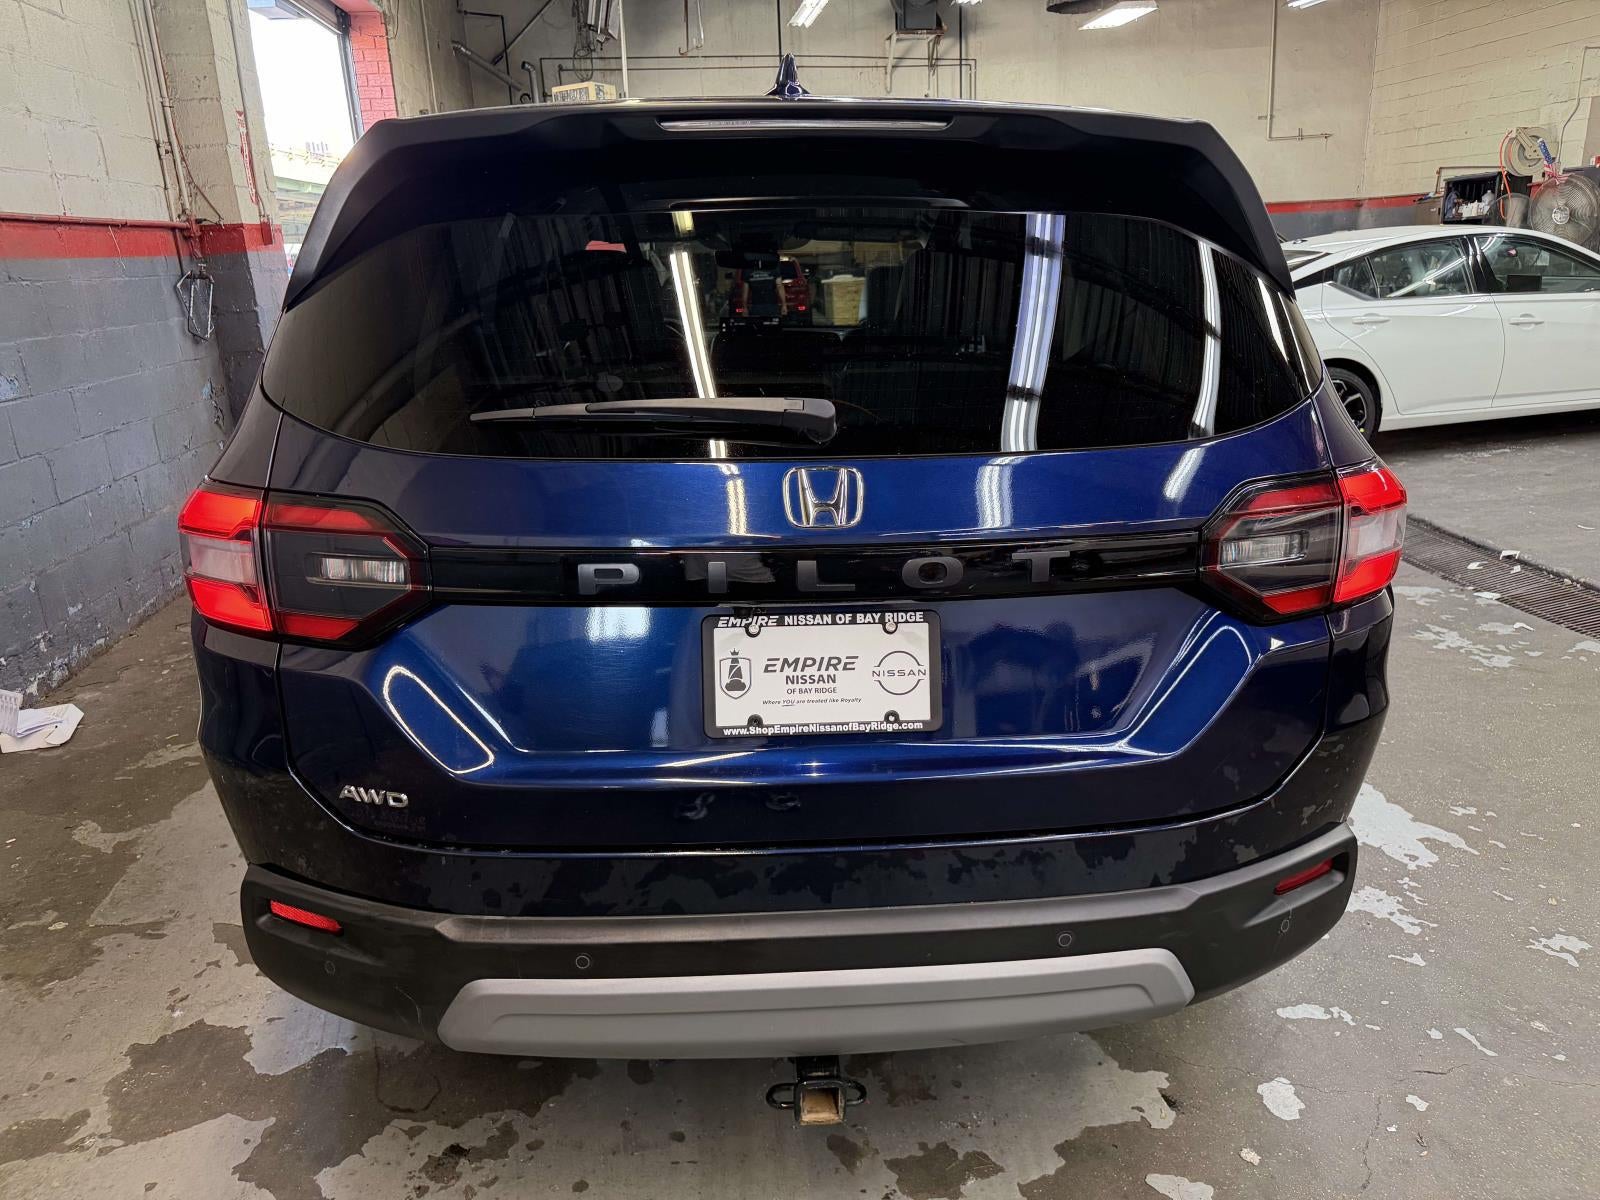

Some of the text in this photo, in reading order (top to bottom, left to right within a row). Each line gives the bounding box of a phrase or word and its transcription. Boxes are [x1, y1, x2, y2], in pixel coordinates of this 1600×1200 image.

[577, 551, 1071, 595] PILOT
[717, 611, 924, 628] EMPIRE NISSAN OF BAY RIDGE
[763, 655, 859, 674] EMPIRE
[785, 674, 837, 685] NISSAN
[872, 668, 926, 678] NISSAN
[786, 686, 837, 695] OF BAY RIDGE
[840, 697, 862, 705] Royalty
[722, 721, 923, 736] www.ShopEmpireNissanofBayRidge.com
[339, 785, 409, 808] AWD
